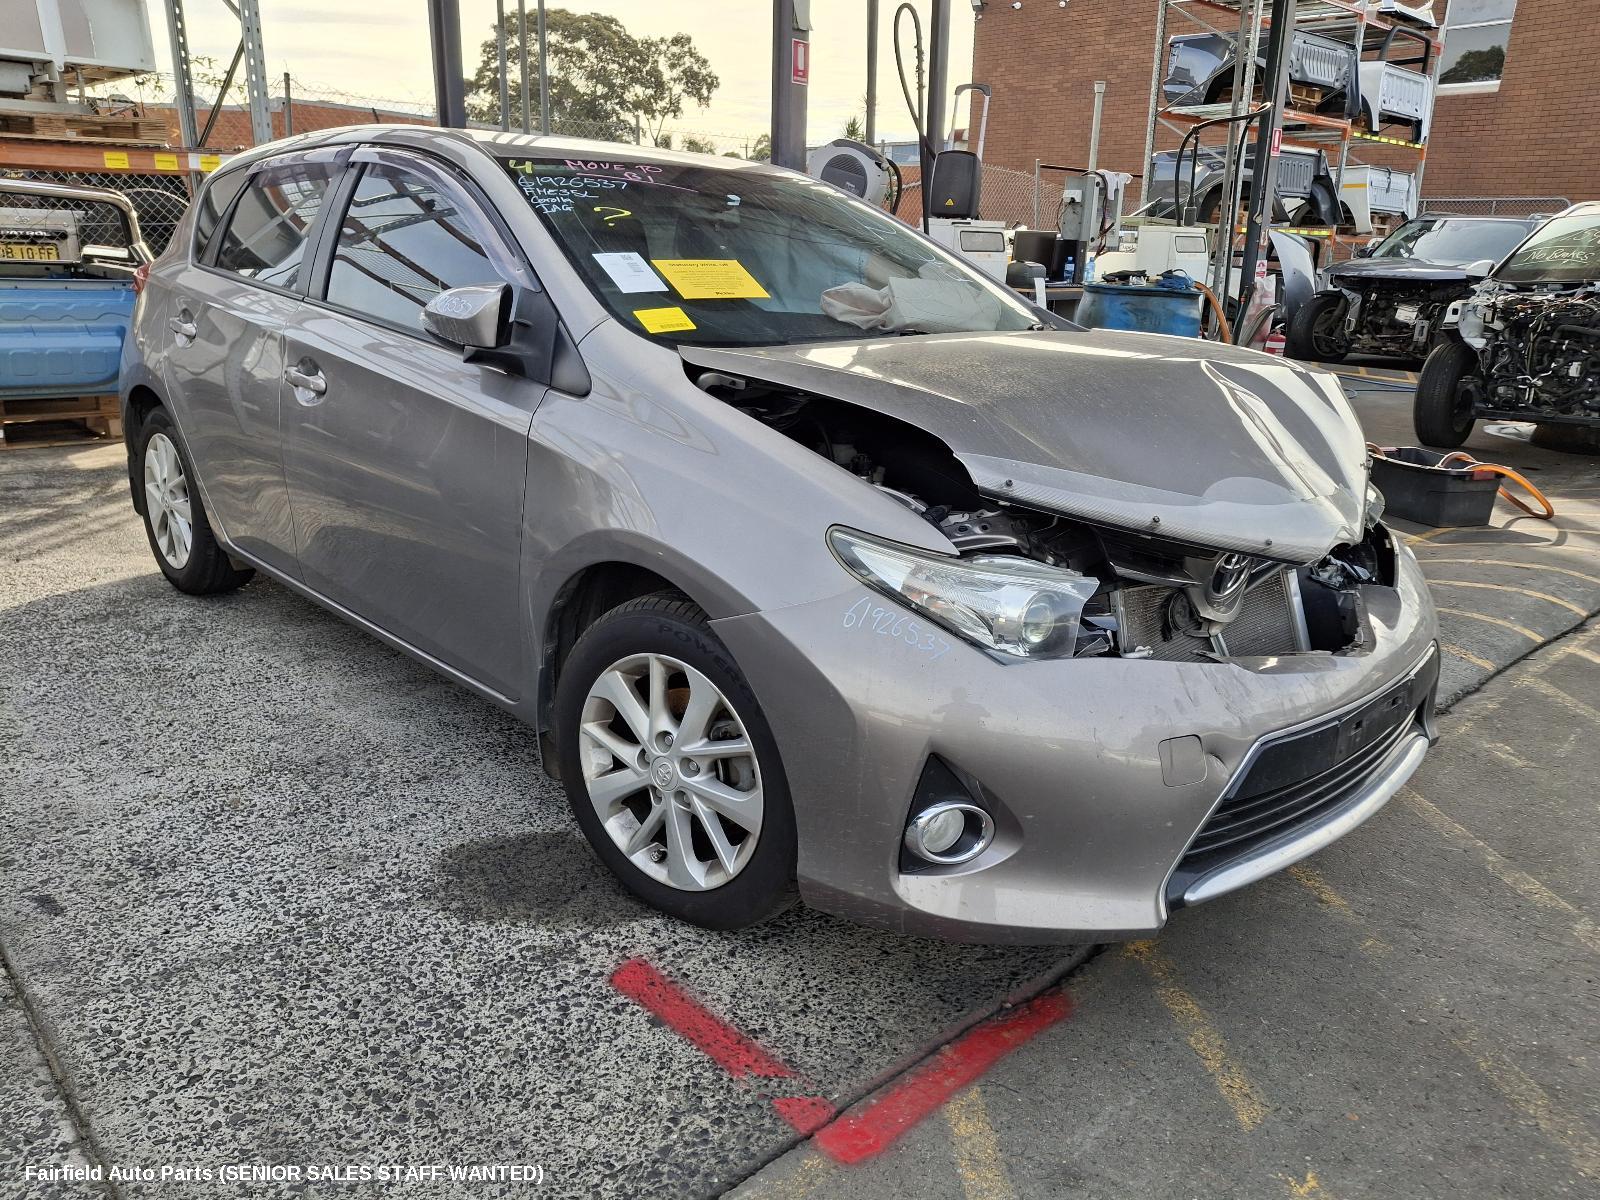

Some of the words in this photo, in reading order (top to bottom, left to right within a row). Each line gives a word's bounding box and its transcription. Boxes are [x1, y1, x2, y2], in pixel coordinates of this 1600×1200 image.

[564, 159, 626, 171] MOVE
[518, 176, 628, 190] 61926537
[842, 596, 951, 660] 61926537
